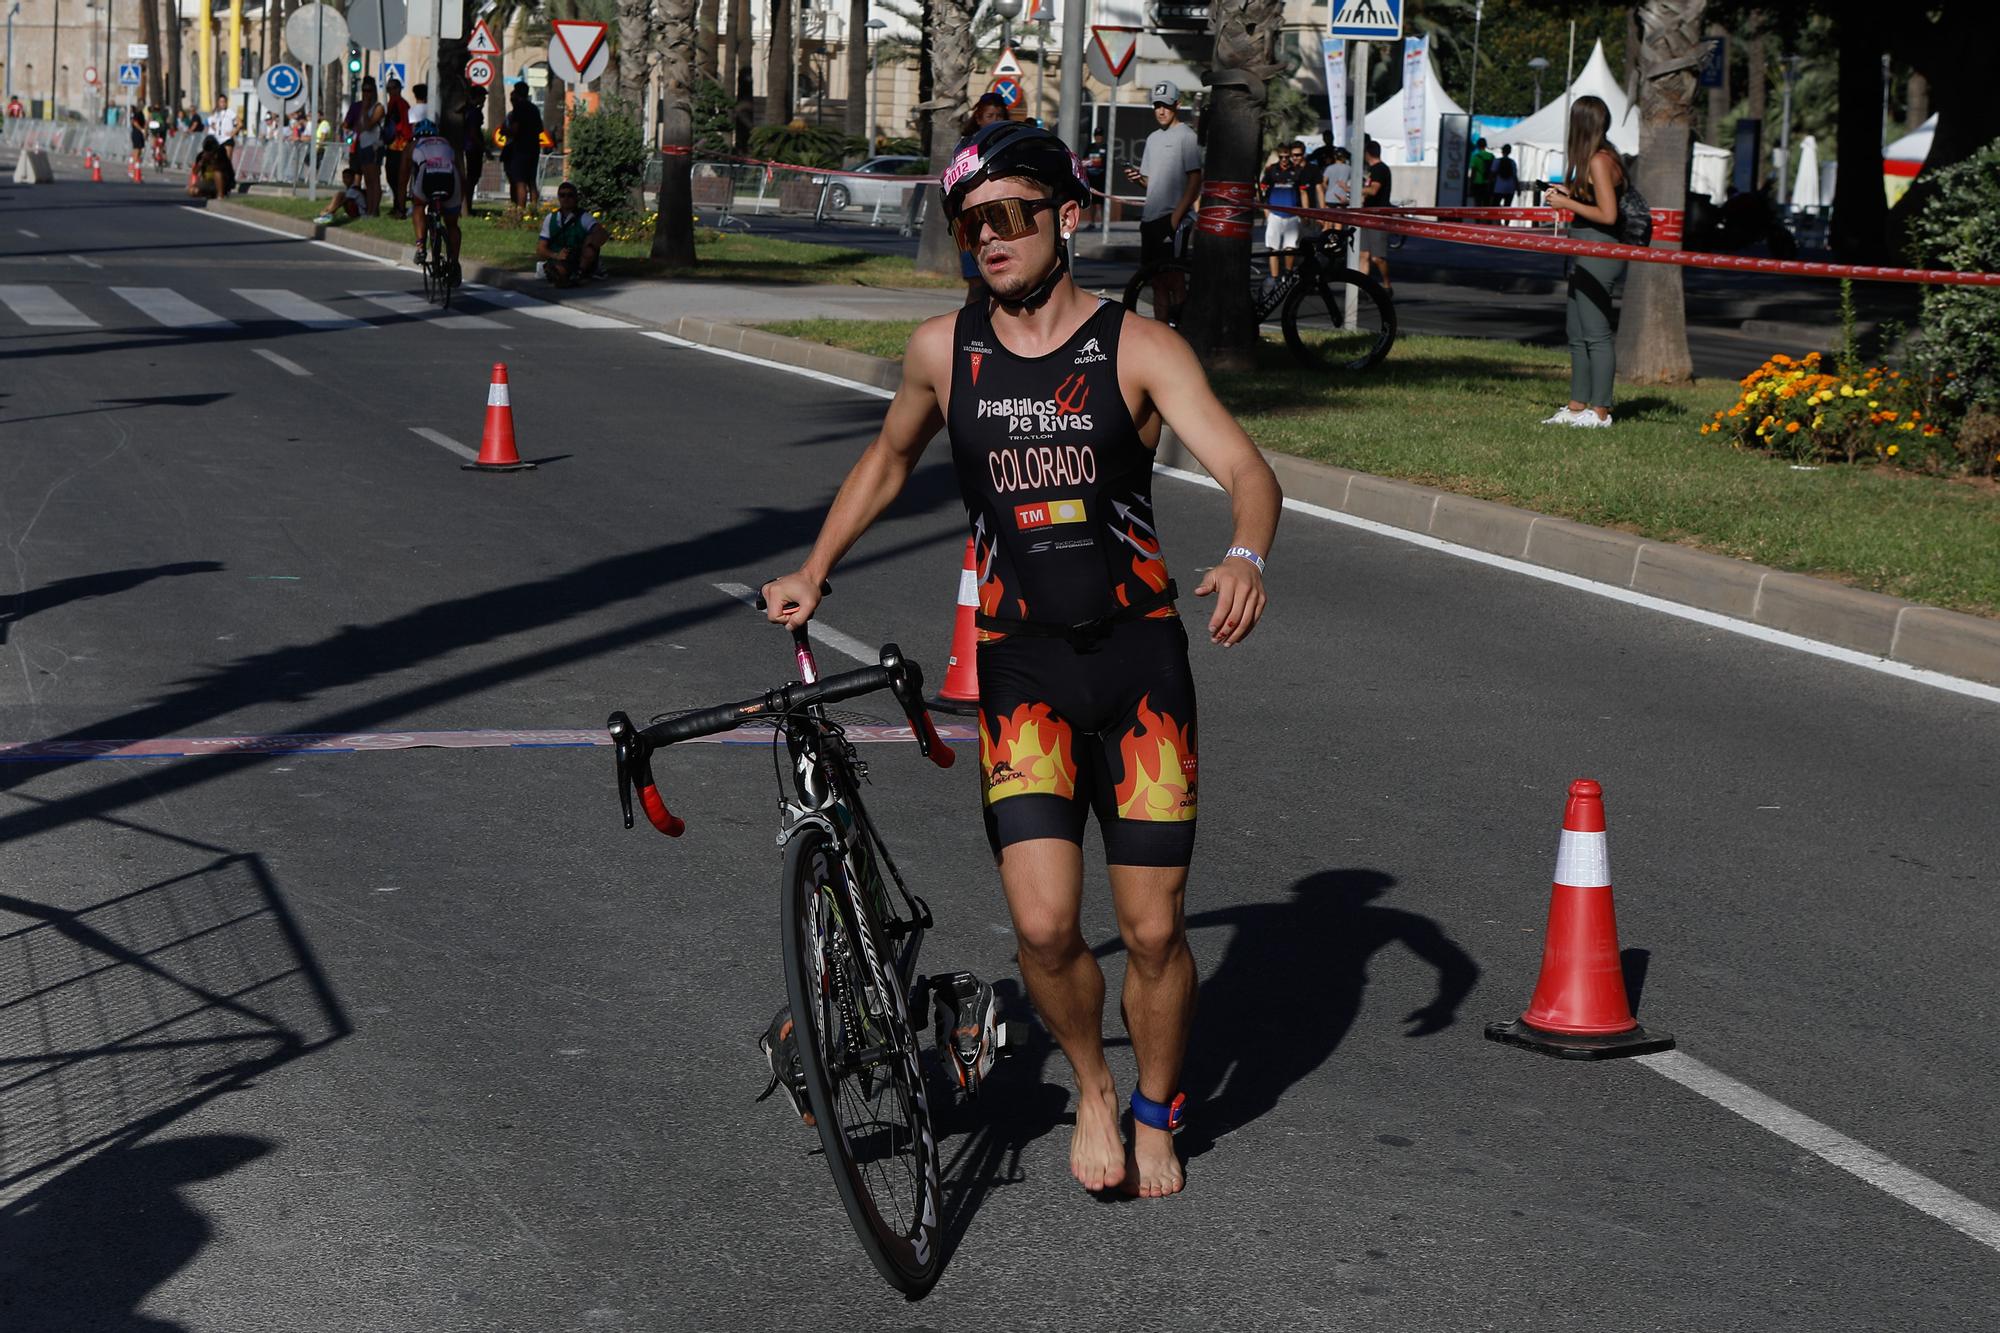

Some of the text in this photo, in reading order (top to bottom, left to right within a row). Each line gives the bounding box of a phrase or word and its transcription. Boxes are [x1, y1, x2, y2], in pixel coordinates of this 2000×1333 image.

[472, 67, 488, 78] 20
[1008, 433, 1054, 442] TRIATLON
[988, 445, 1097, 494] COLORADO
[1019, 509, 1045, 525] TM
